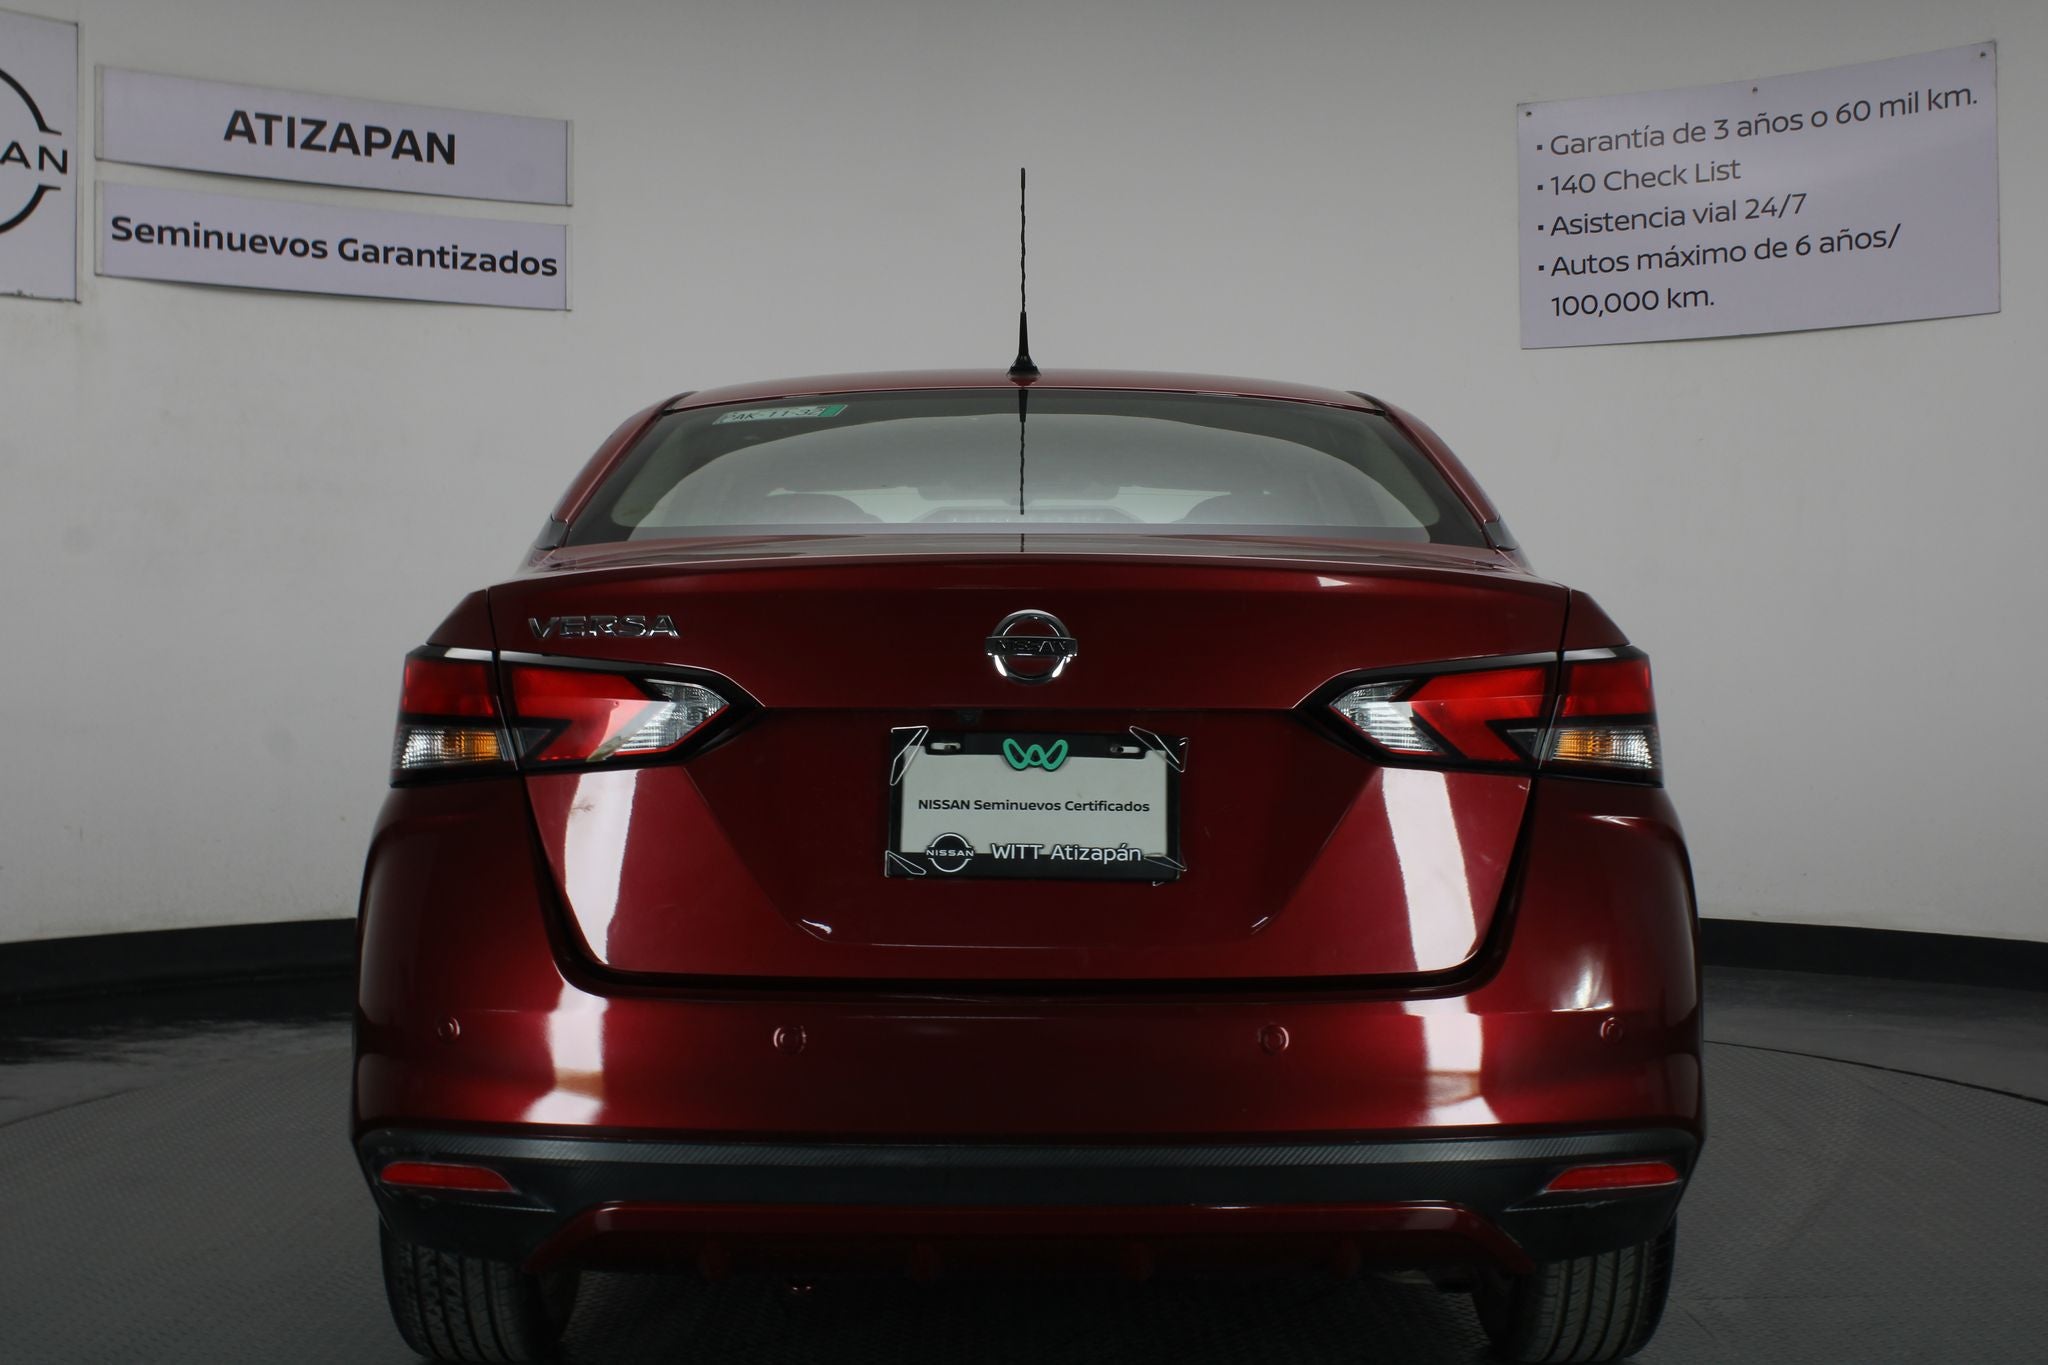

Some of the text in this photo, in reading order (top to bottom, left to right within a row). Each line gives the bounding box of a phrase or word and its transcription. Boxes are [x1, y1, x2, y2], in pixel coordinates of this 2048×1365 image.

[223, 110, 456, 166] ATIZAPAN
[1550, 88, 1978, 156] Garantía de 3 años o 60 mil km.
[1550, 159, 1742, 196] 140 Check List
[1550, 192, 1807, 237] Asistencia vial 24/7
[111, 216, 558, 277] Seminuevos Garantizados
[1551, 223, 1902, 277] Autos máximo de 6 años/
[1551, 287, 1715, 318] 100,000 km.
[528, 615, 681, 639] VERSA
[918, 799, 1150, 812] NISSAN Seminuevos Certificados
[926, 849, 974, 857] NISSAN
[991, 843, 1142, 864] WITT Atizapán
